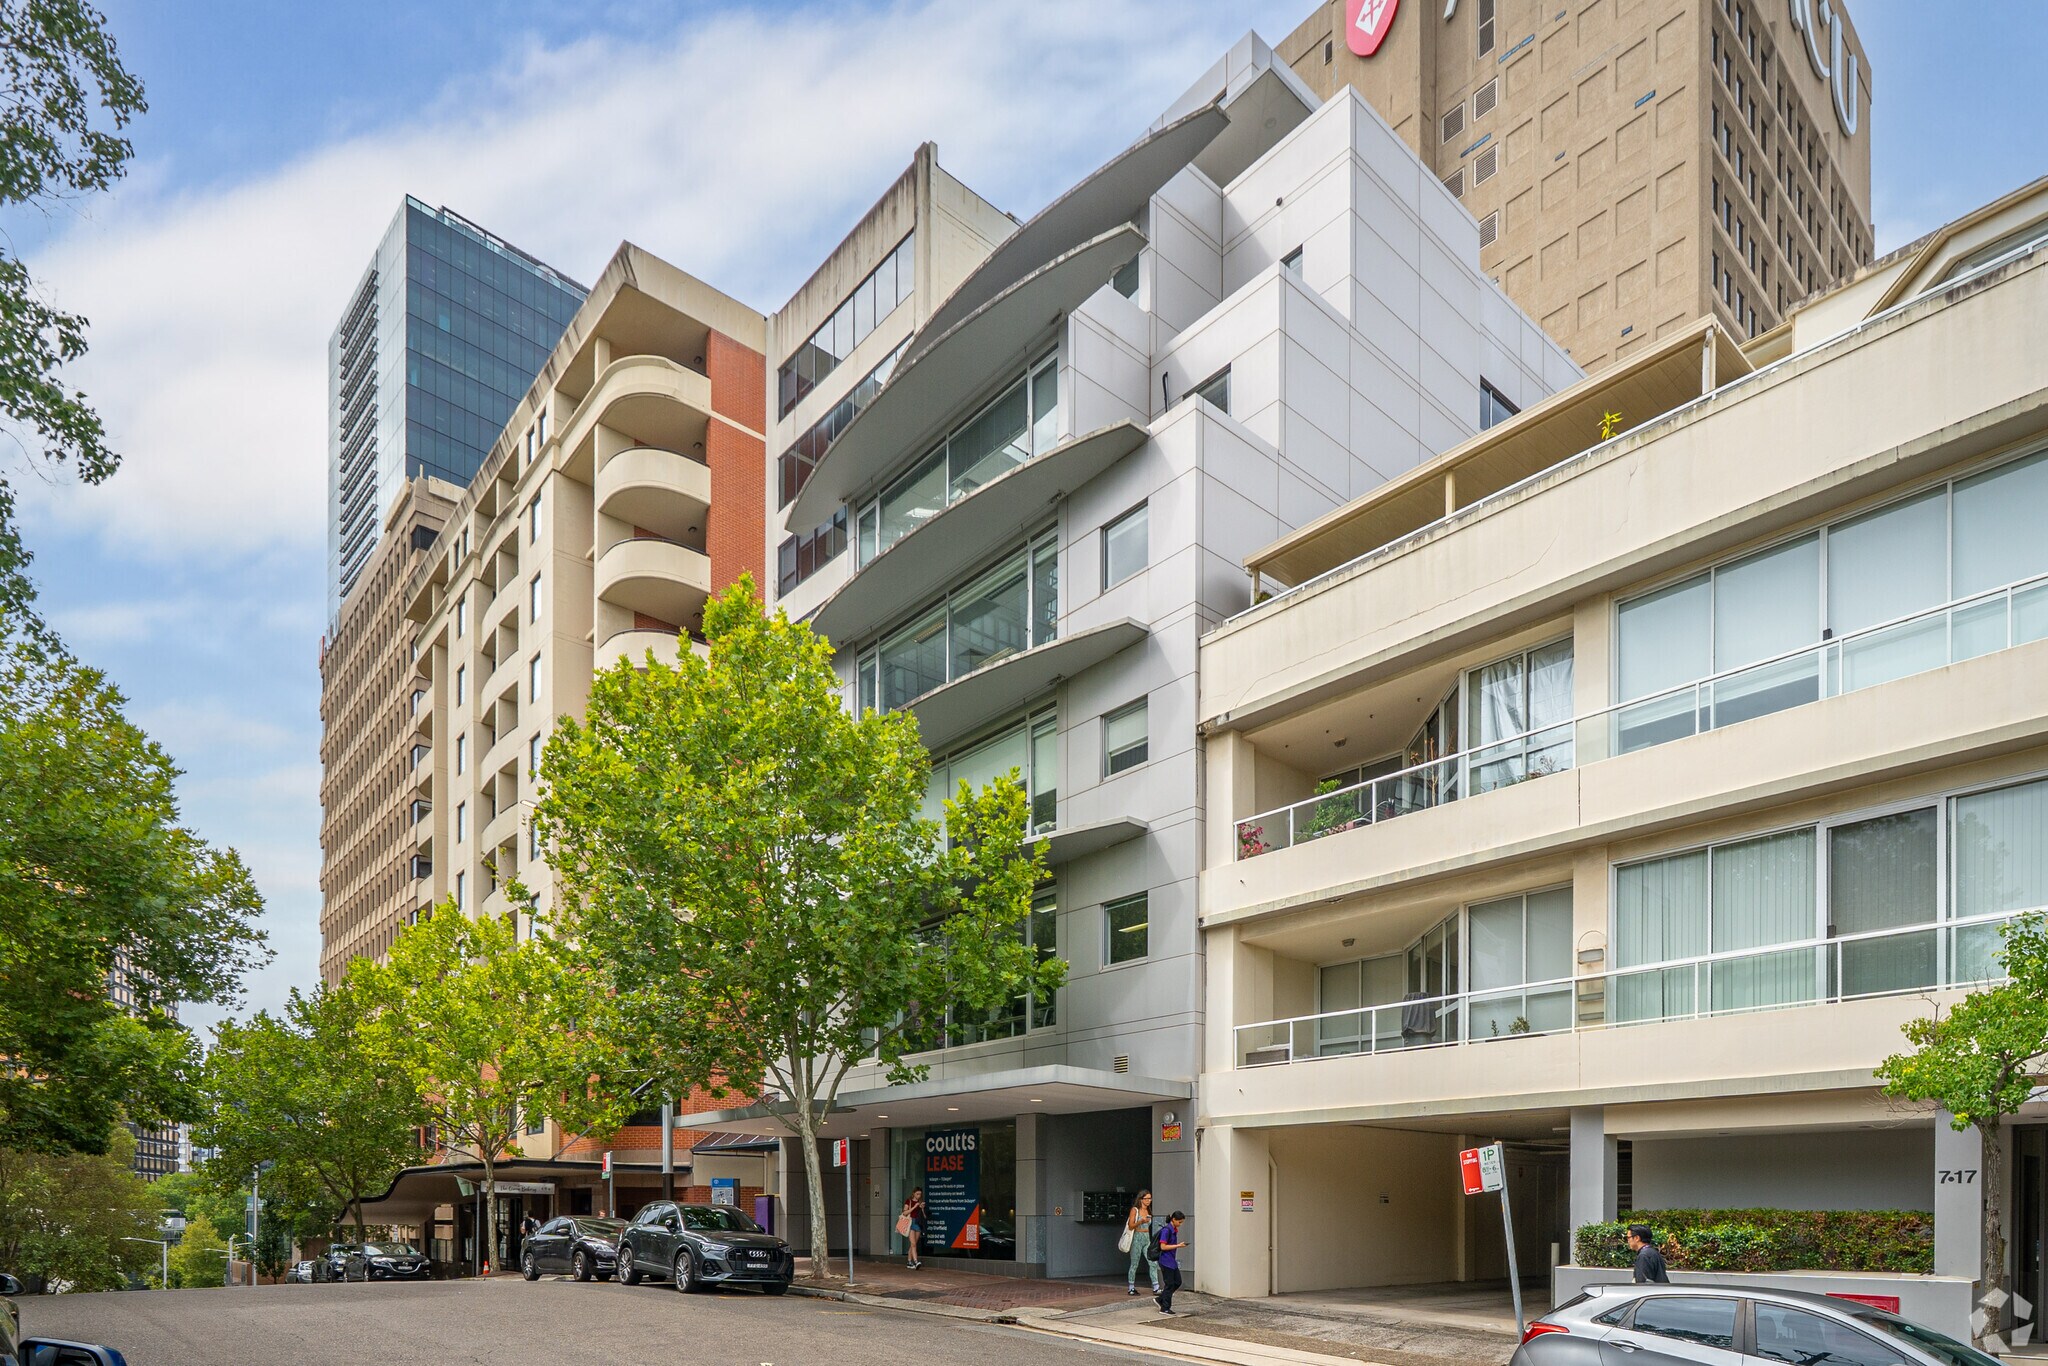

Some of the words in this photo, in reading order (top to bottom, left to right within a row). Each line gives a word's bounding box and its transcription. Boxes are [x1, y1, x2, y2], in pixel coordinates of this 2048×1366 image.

[926, 1132, 976, 1153] coutts
[927, 1155, 964, 1172] LEASE
[1483, 1149, 1494, 1161] 1P
